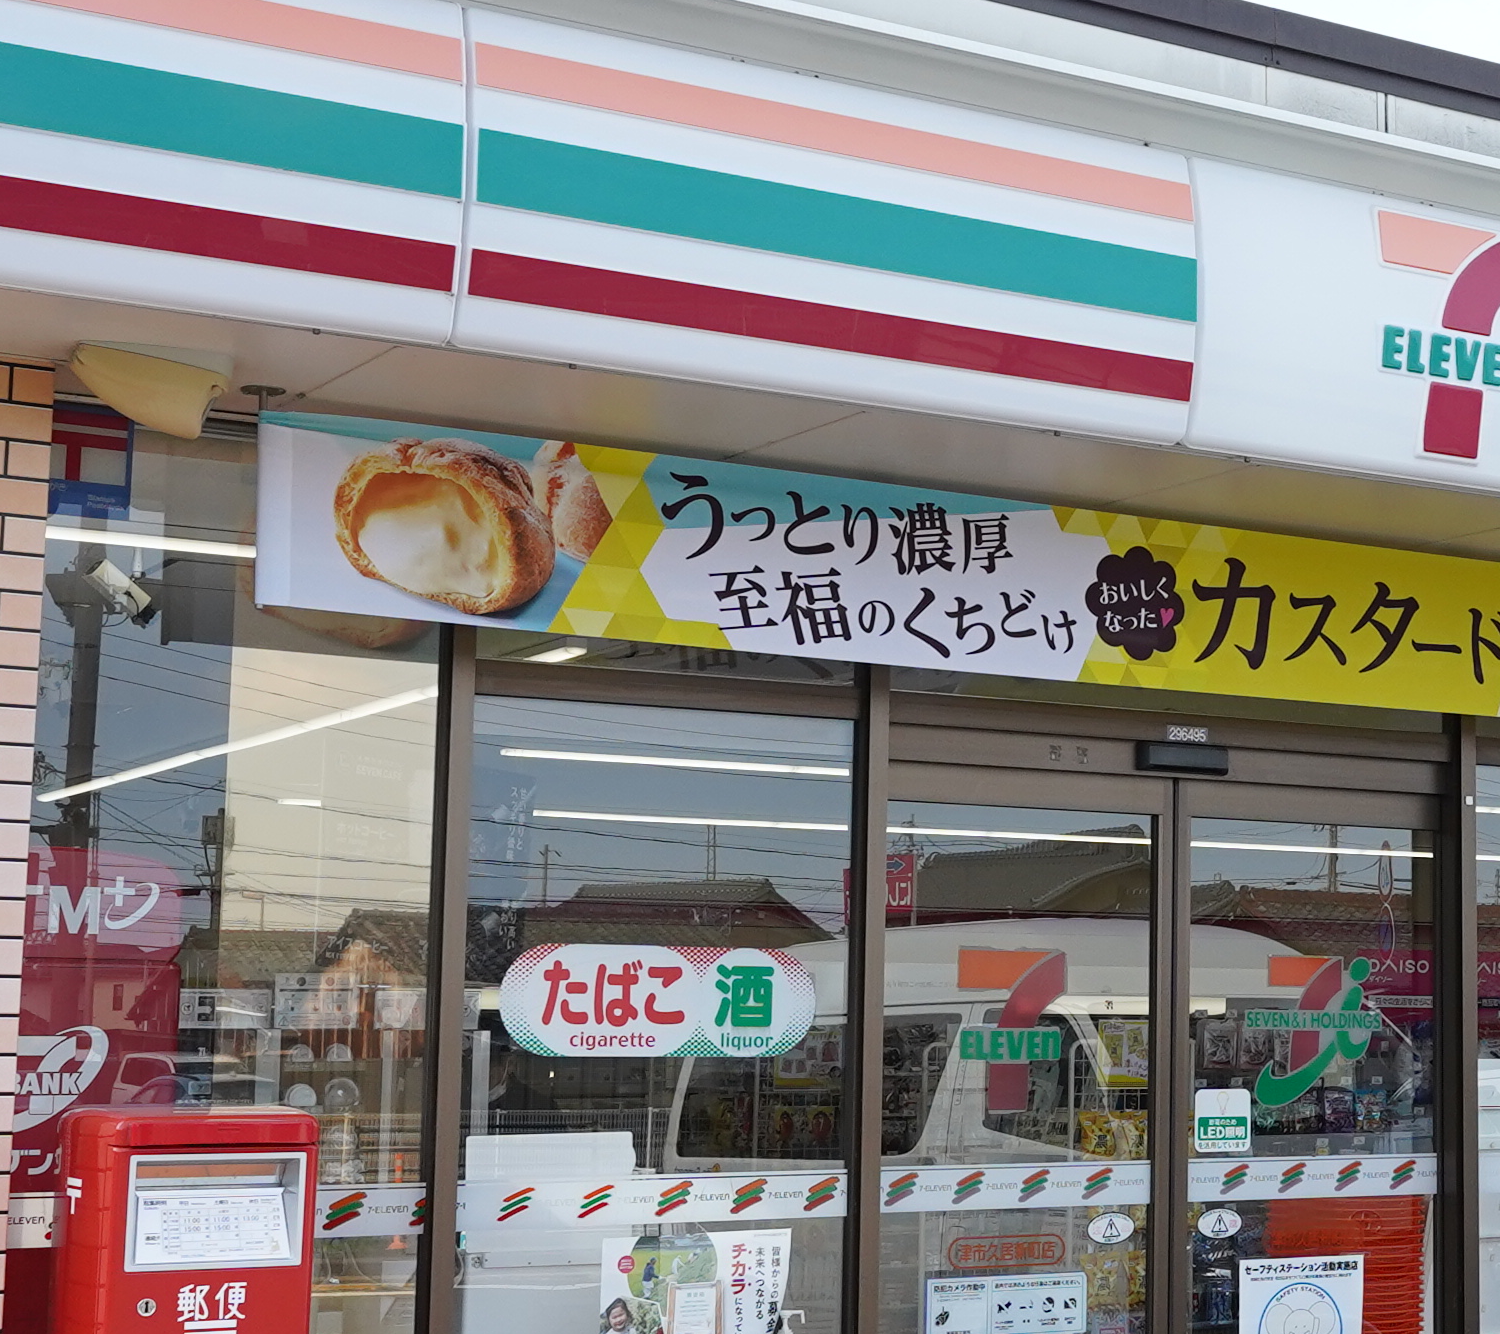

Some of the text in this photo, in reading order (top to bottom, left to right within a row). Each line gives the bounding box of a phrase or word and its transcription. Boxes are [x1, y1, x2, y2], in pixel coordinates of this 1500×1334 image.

[662, 471, 1013, 577] うっとり濃厚
[1099, 577, 1170, 609] おいしく
[713, 564, 1077, 659] 至福のくちどけ
[1102, 606, 1158, 633] なった
[1168, 727, 1206, 742] 296495
[542, 959, 685, 1027] たばこ
[714, 964, 774, 1027] 酒
[1310, 1013, 1381, 1029] HOLDINGS
[569, 1032, 655, 1051] cigarette
[721, 1033, 773, 1051] liquor
[1200, 1126, 1245, 1139] LED照明
[958, 1241, 1056, 1263] 津市久居新町店
[1245, 1260, 1358, 1275] セーフティステーション活動実施店
[755, 1247, 766, 1320] 未来へつながる
[933, 1283, 986, 1293] 防犯カメラ作動中
[1275, 1286, 1326, 1302] SAFETY STATION
[177, 1282, 247, 1322] 郵便
